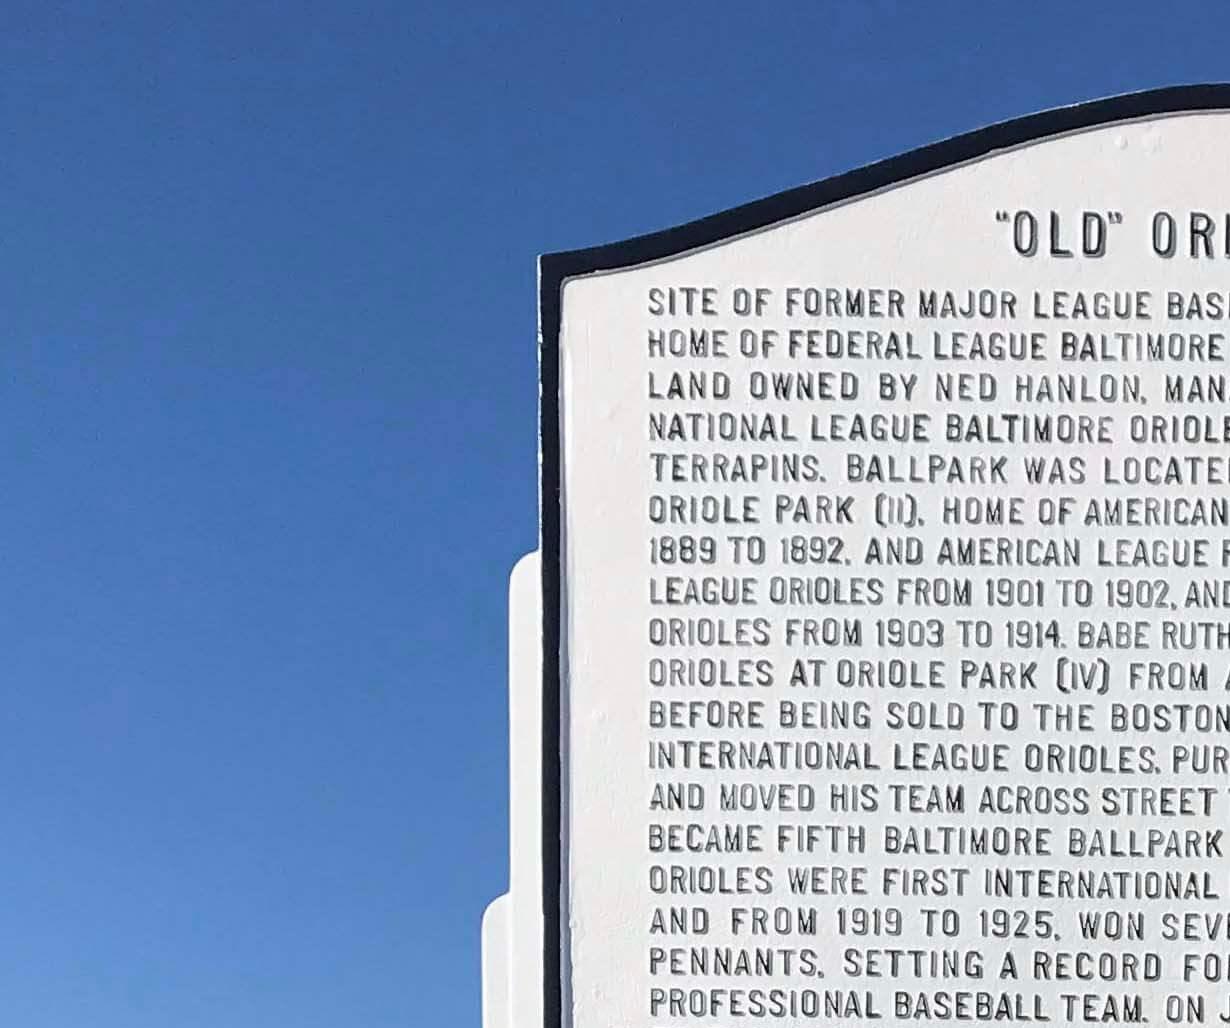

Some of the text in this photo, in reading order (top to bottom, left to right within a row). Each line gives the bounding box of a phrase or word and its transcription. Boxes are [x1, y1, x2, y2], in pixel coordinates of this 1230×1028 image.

[648, 287, 718, 316] SITE
[733, 287, 772, 317] OF
[785, 287, 905, 318] FORMER
[918, 289, 1017, 320] MAJOR
[1033, 291, 1152, 320] LEAGUE
[648, 370, 731, 401] LAND
[749, 371, 859, 401] OWNED
[879, 372, 918, 402] BY
[935, 372, 997, 402] NED
[1015, 374, 1147, 405] HANLON,
[649, 452, 827, 483] TERRAPINS.
[847, 453, 1008, 484] BALLPARK
[1023, 456, 1086, 485] WAS
[649, 576, 757, 606] LEAGUE
[769, 576, 884, 606] ORIOLES
[897, 577, 972, 607] FROM
[986, 578, 1044, 608] 1901
[1055, 579, 1093, 608] TO
[1105, 579, 1178, 611] 1902,
[649, 658, 774, 688] ORIOLES
[789, 658, 827, 688] AT
[836, 659, 946, 689] ORIOLE
[961, 659, 1038, 690] PARK
[1056, 656, 1111, 696] (IV)
[1129, 661, 1209, 691] FROM
[648, 823, 763, 853] BECAME
[777, 824, 866, 854] FIFTH
[884, 825, 1052, 857] BALTIMORE
[1068, 827, 1224, 859] BALLPARK
[649, 906, 710, 935] AND
[731, 906, 818, 936] FROM
[837, 907, 903, 937] 1919
[919, 908, 960, 938] TO
[979, 908, 1062, 942] 1925,
[1078, 910, 1145, 942] WON
[650, 988, 883, 1020] PROFESSIONAL
[894, 991, 1051, 1023] BASEBALL
[1059, 993, 1149, 1024] TEAM.
[1166, 995, 1205, 1024] ON
